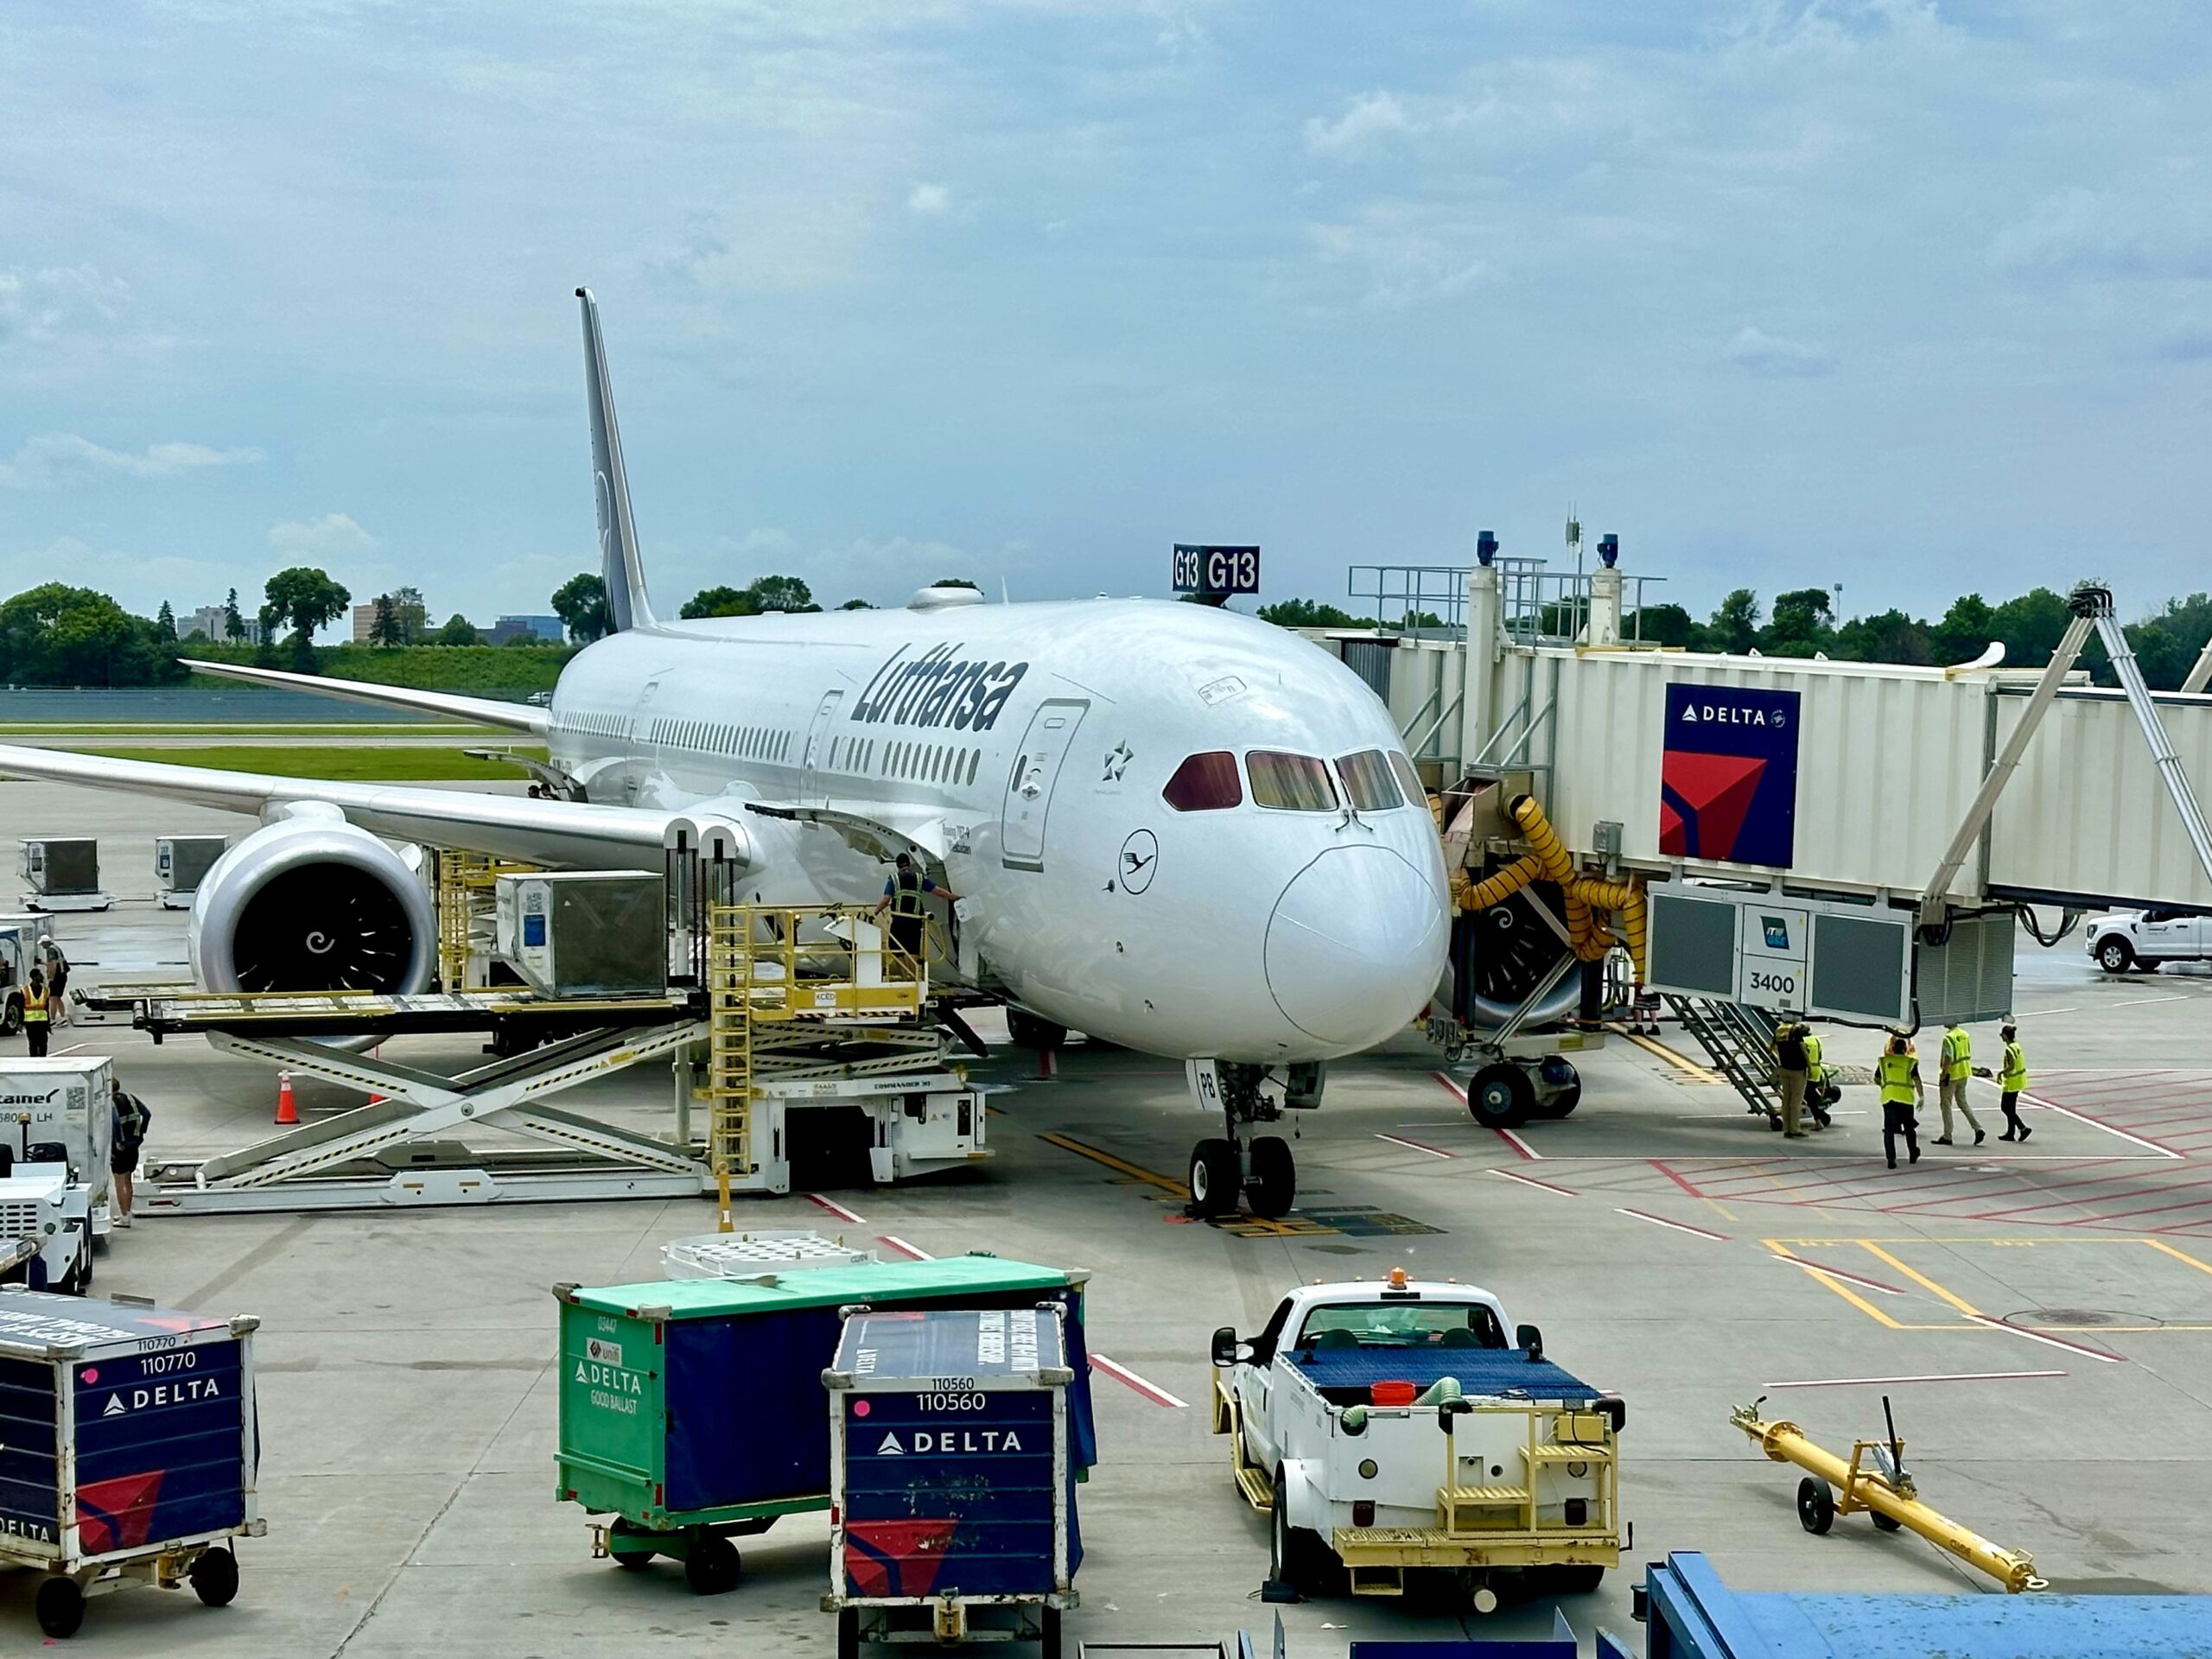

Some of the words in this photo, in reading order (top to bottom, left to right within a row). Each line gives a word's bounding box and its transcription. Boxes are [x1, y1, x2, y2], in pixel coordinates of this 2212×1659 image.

[1175, 550, 1198, 588] G13
[1208, 552, 1255, 588] G13
[850, 642, 1029, 732] Lufthansa
[1703, 706, 1765, 726] DELTA
[1751, 972, 1795, 994] 3400
[37, 1113, 53, 1122] LH
[137, 1337, 176, 1351] 110770
[140, 1351, 196, 1375] 110770
[591, 1364, 641, 1395] DELTA
[931, 1377, 975, 1390] 110560
[134, 1378, 219, 1409] DELTA
[590, 1389, 610, 1408] GOOD
[610, 1394, 637, 1414] BALLAST
[917, 1393, 986, 1411] 110560
[914, 1431, 1022, 1452] DELTA
